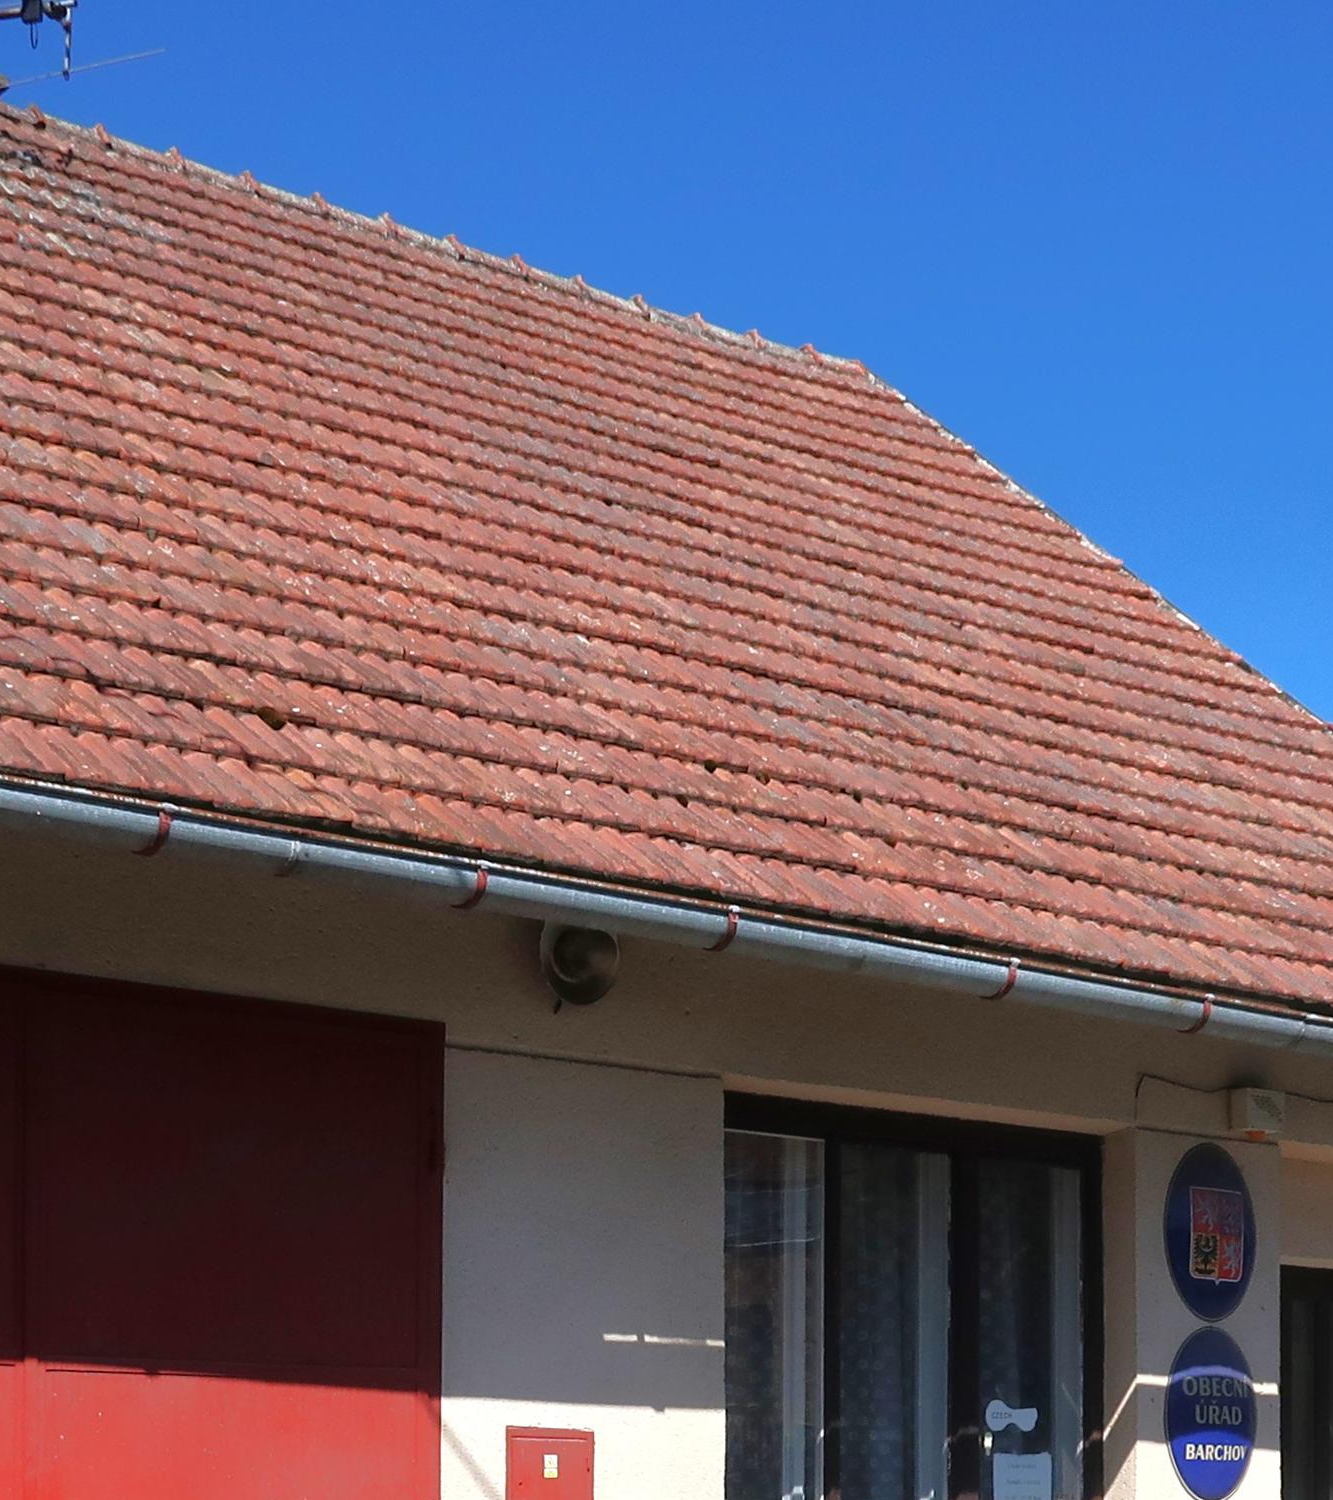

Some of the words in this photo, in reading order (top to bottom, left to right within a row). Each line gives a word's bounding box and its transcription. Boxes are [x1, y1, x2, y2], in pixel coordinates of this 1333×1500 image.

[1182, 1375, 1248, 1398] OBECNÍ
[1194, 1399, 1243, 1425] ÚŘAD
[1184, 1443, 1248, 1461] BARCHOV
